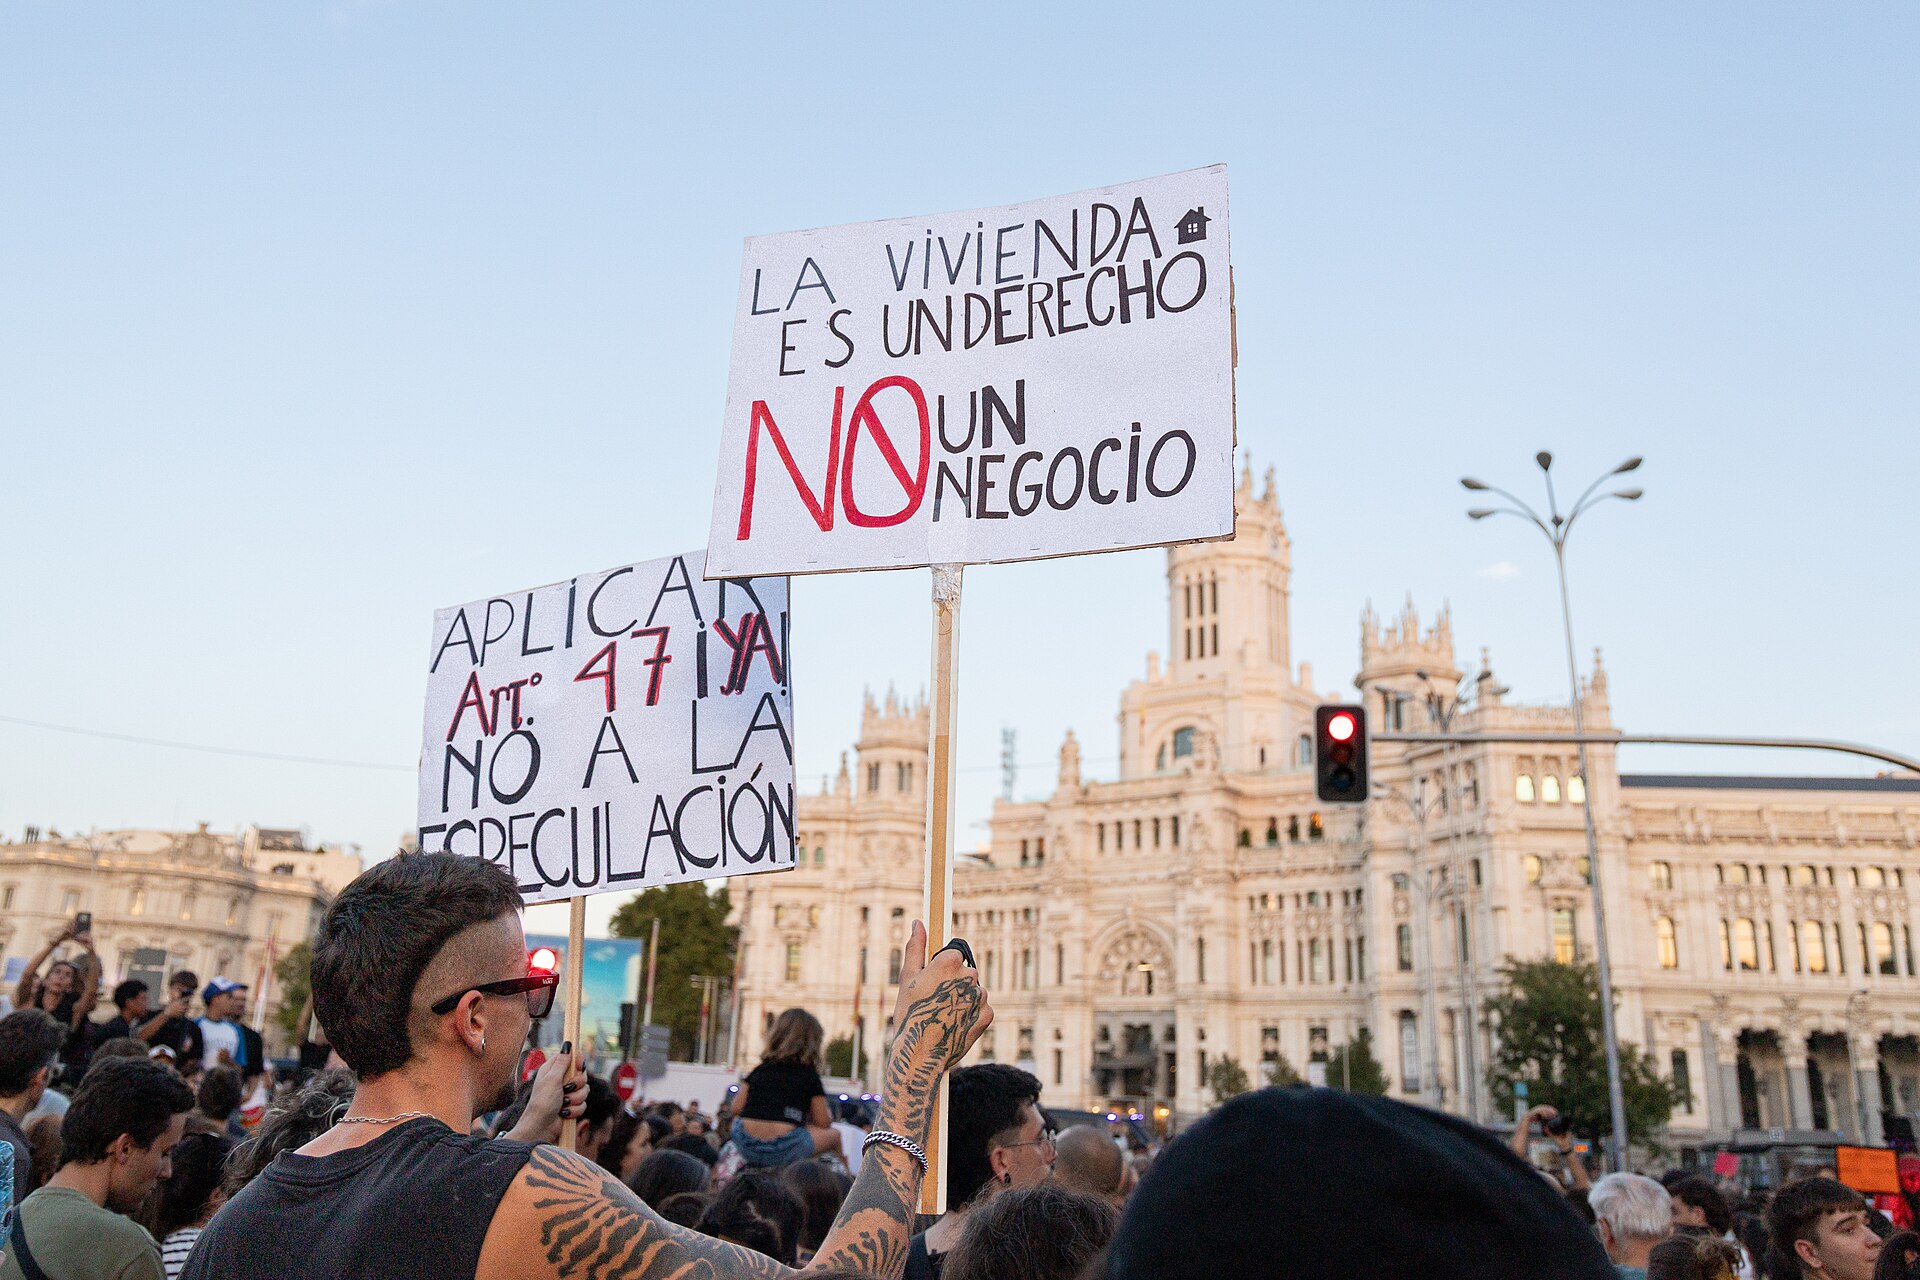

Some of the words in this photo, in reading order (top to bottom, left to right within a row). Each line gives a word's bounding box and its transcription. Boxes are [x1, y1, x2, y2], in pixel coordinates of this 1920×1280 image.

[752, 257, 836, 316] LA
[779, 309, 855, 376] ES
[737, 375, 931, 540] NO
[937, 379, 1025, 454] UN
[573, 626, 672, 712] 47
[442, 729, 541, 812] NO
[582, 716, 639, 788] A
[691, 692, 792, 774] LA
